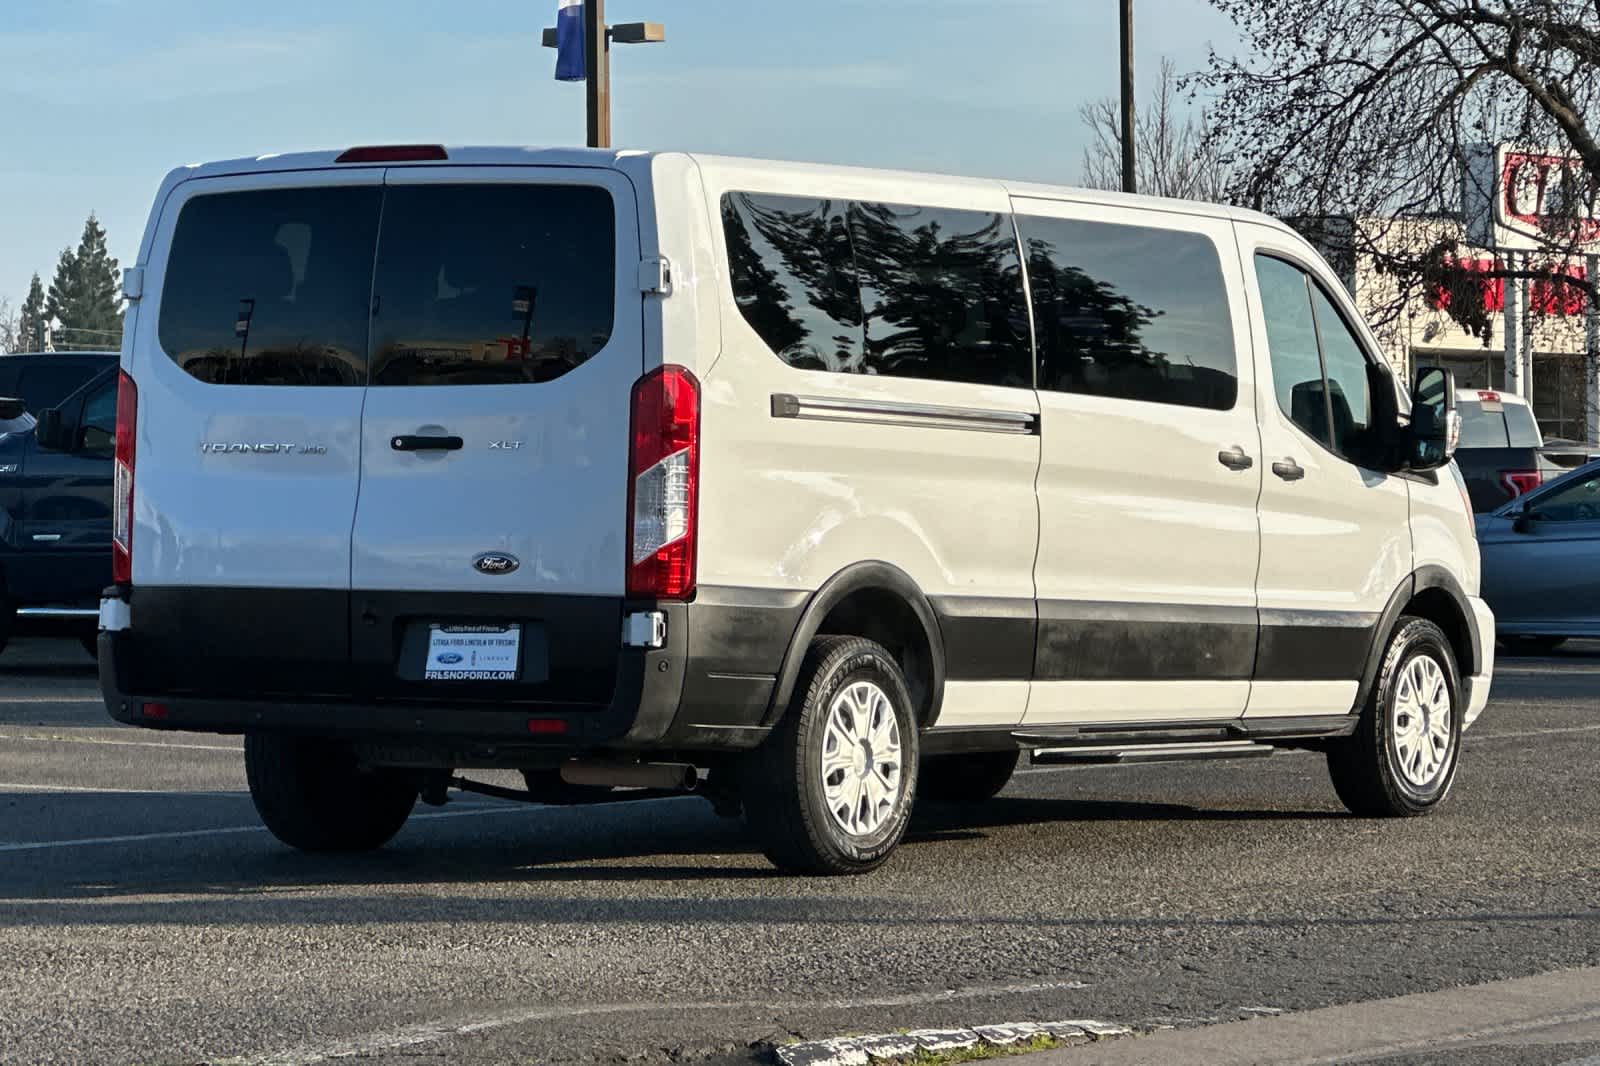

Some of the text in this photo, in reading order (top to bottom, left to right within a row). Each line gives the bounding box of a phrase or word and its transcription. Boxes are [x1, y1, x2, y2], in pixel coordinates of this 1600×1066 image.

[201, 442, 296, 454] TRANSIT
[488, 440, 526, 449] XLT
[481, 557, 508, 569] Ford
[425, 671, 515, 681] FRESNOFORD.COM
